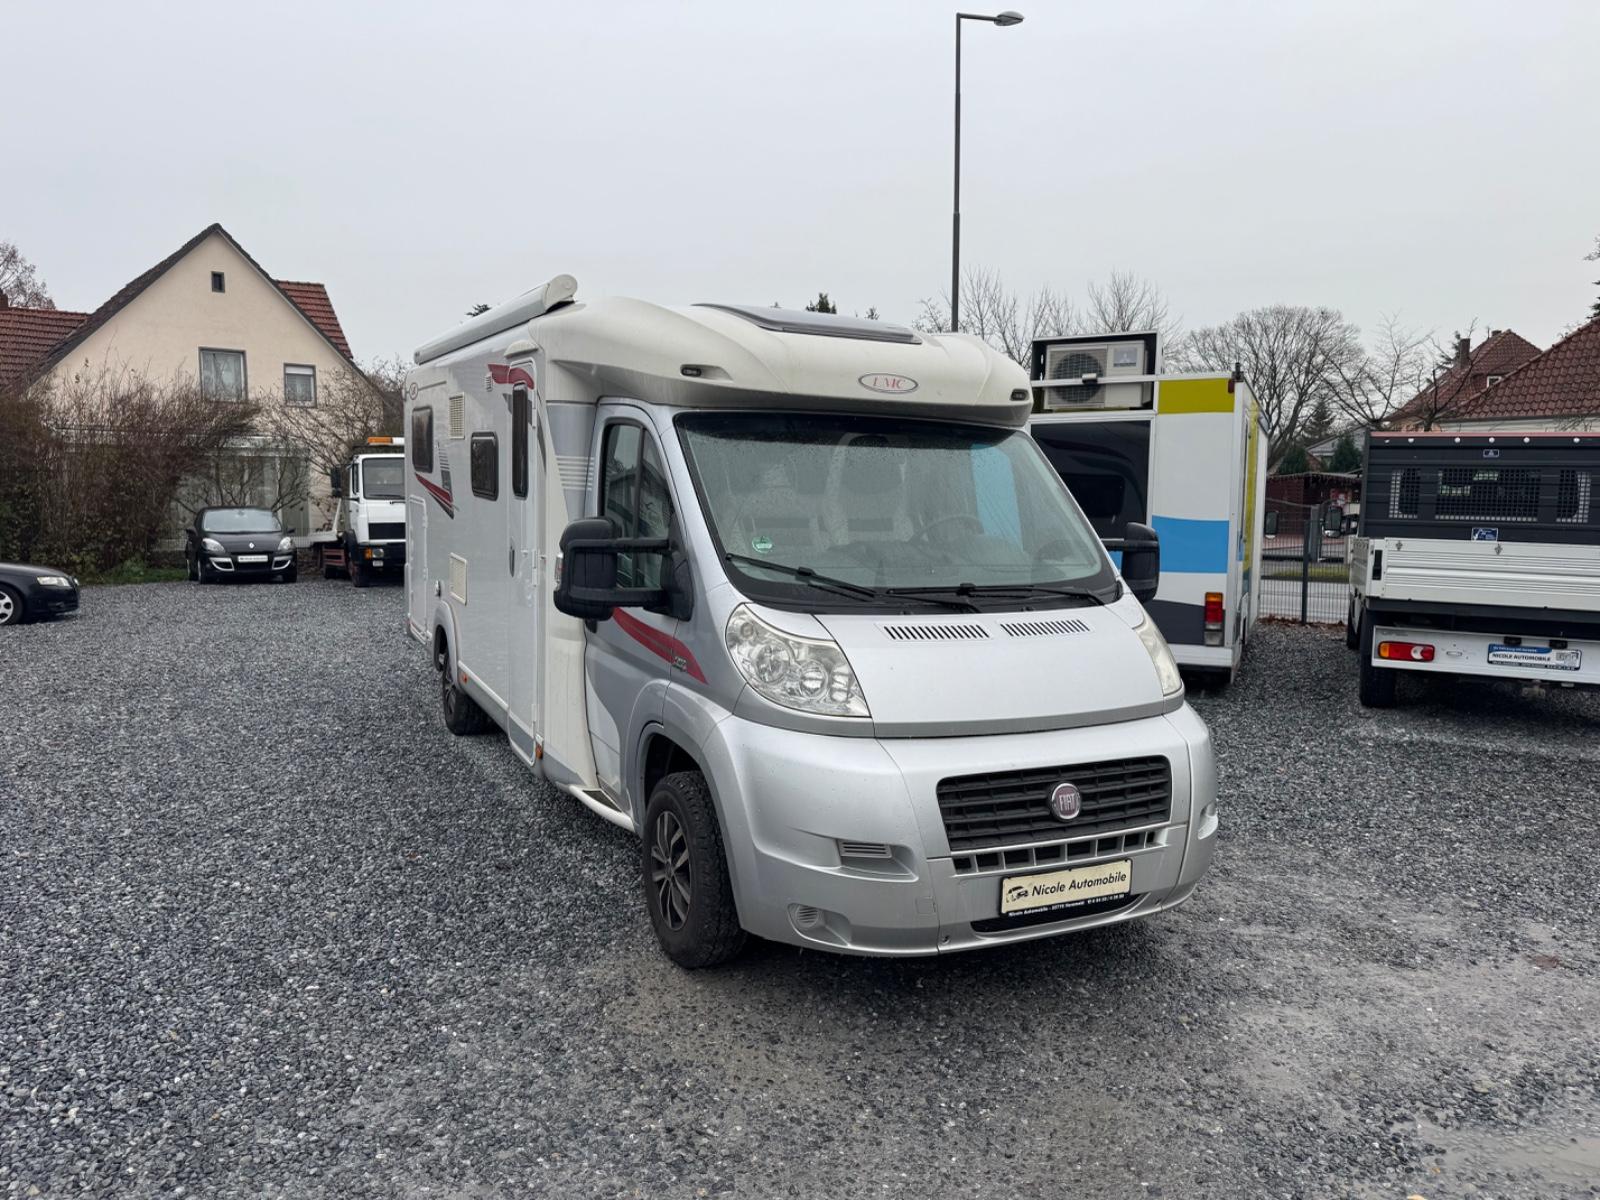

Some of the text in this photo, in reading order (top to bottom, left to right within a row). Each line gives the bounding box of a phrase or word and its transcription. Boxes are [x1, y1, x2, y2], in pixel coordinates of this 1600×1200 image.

[1513, 654, 1551, 662] AUTOMOBILE
[1058, 793, 1075, 811] FIAT
[1032, 871, 1127, 897] Nicole Automobile
